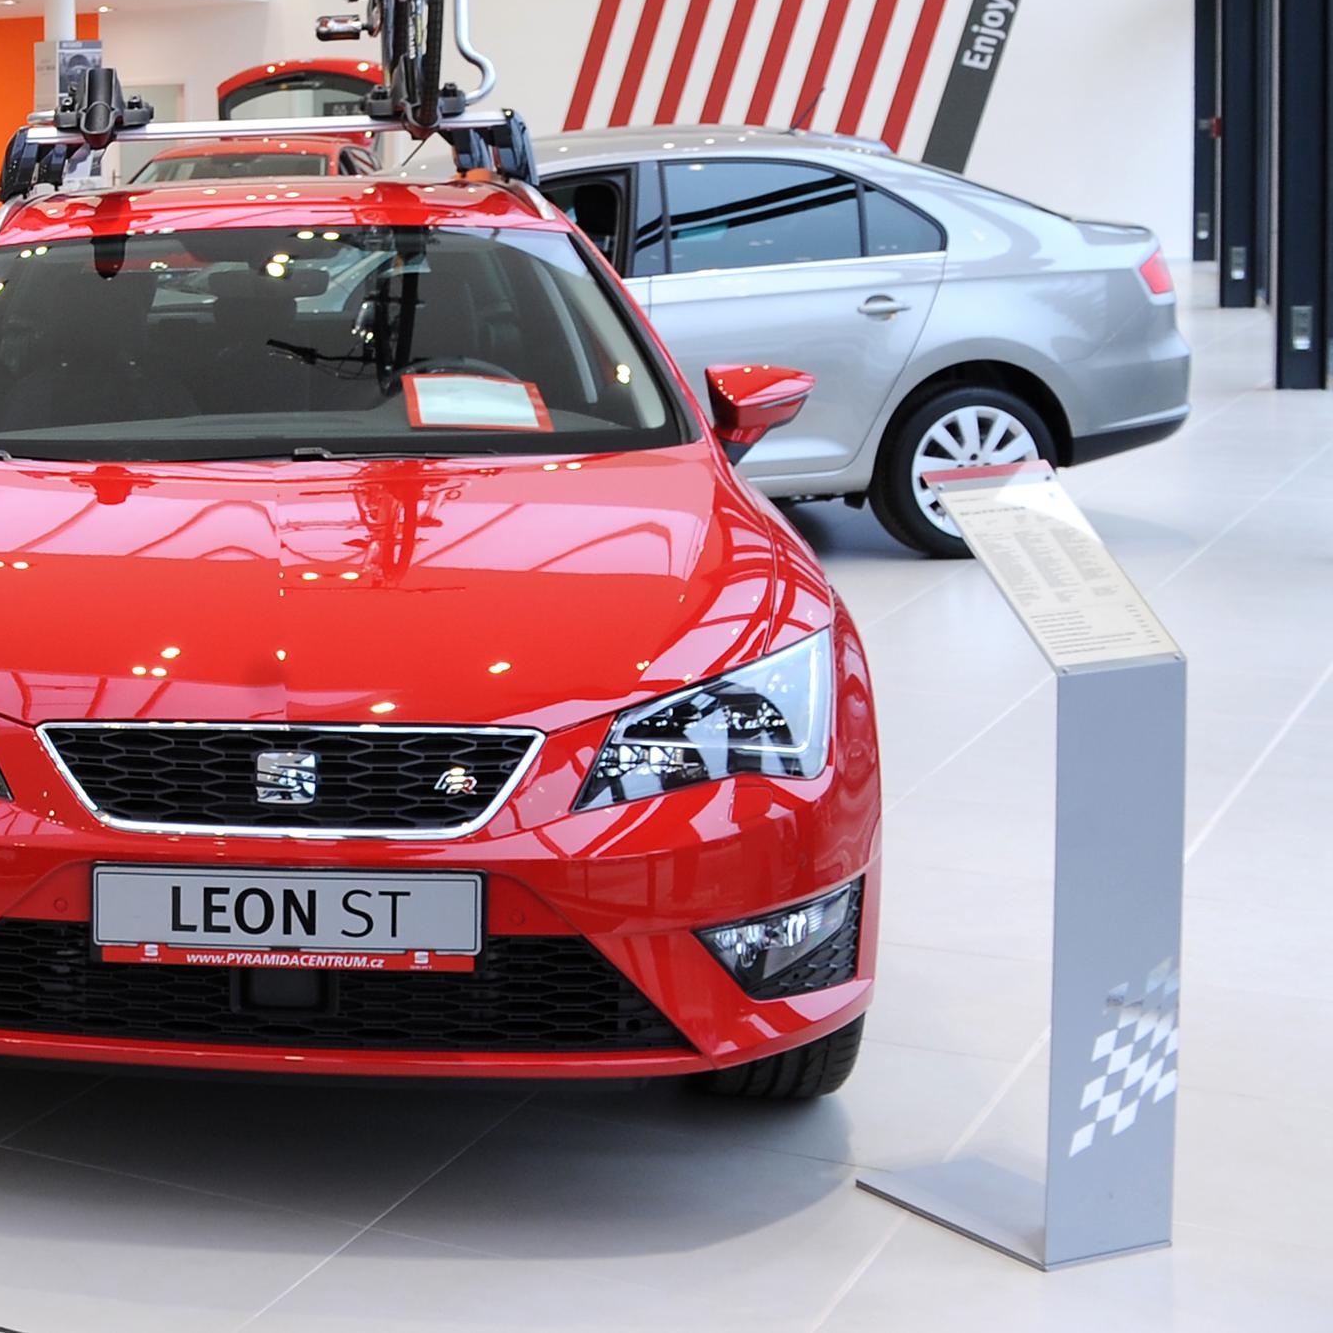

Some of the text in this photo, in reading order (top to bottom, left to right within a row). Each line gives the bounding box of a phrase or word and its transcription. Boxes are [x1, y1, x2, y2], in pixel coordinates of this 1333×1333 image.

[171, 885, 412, 938] LEON ST
[186, 953, 386, 969] www.PYRAMIDACENTRUM.cz
